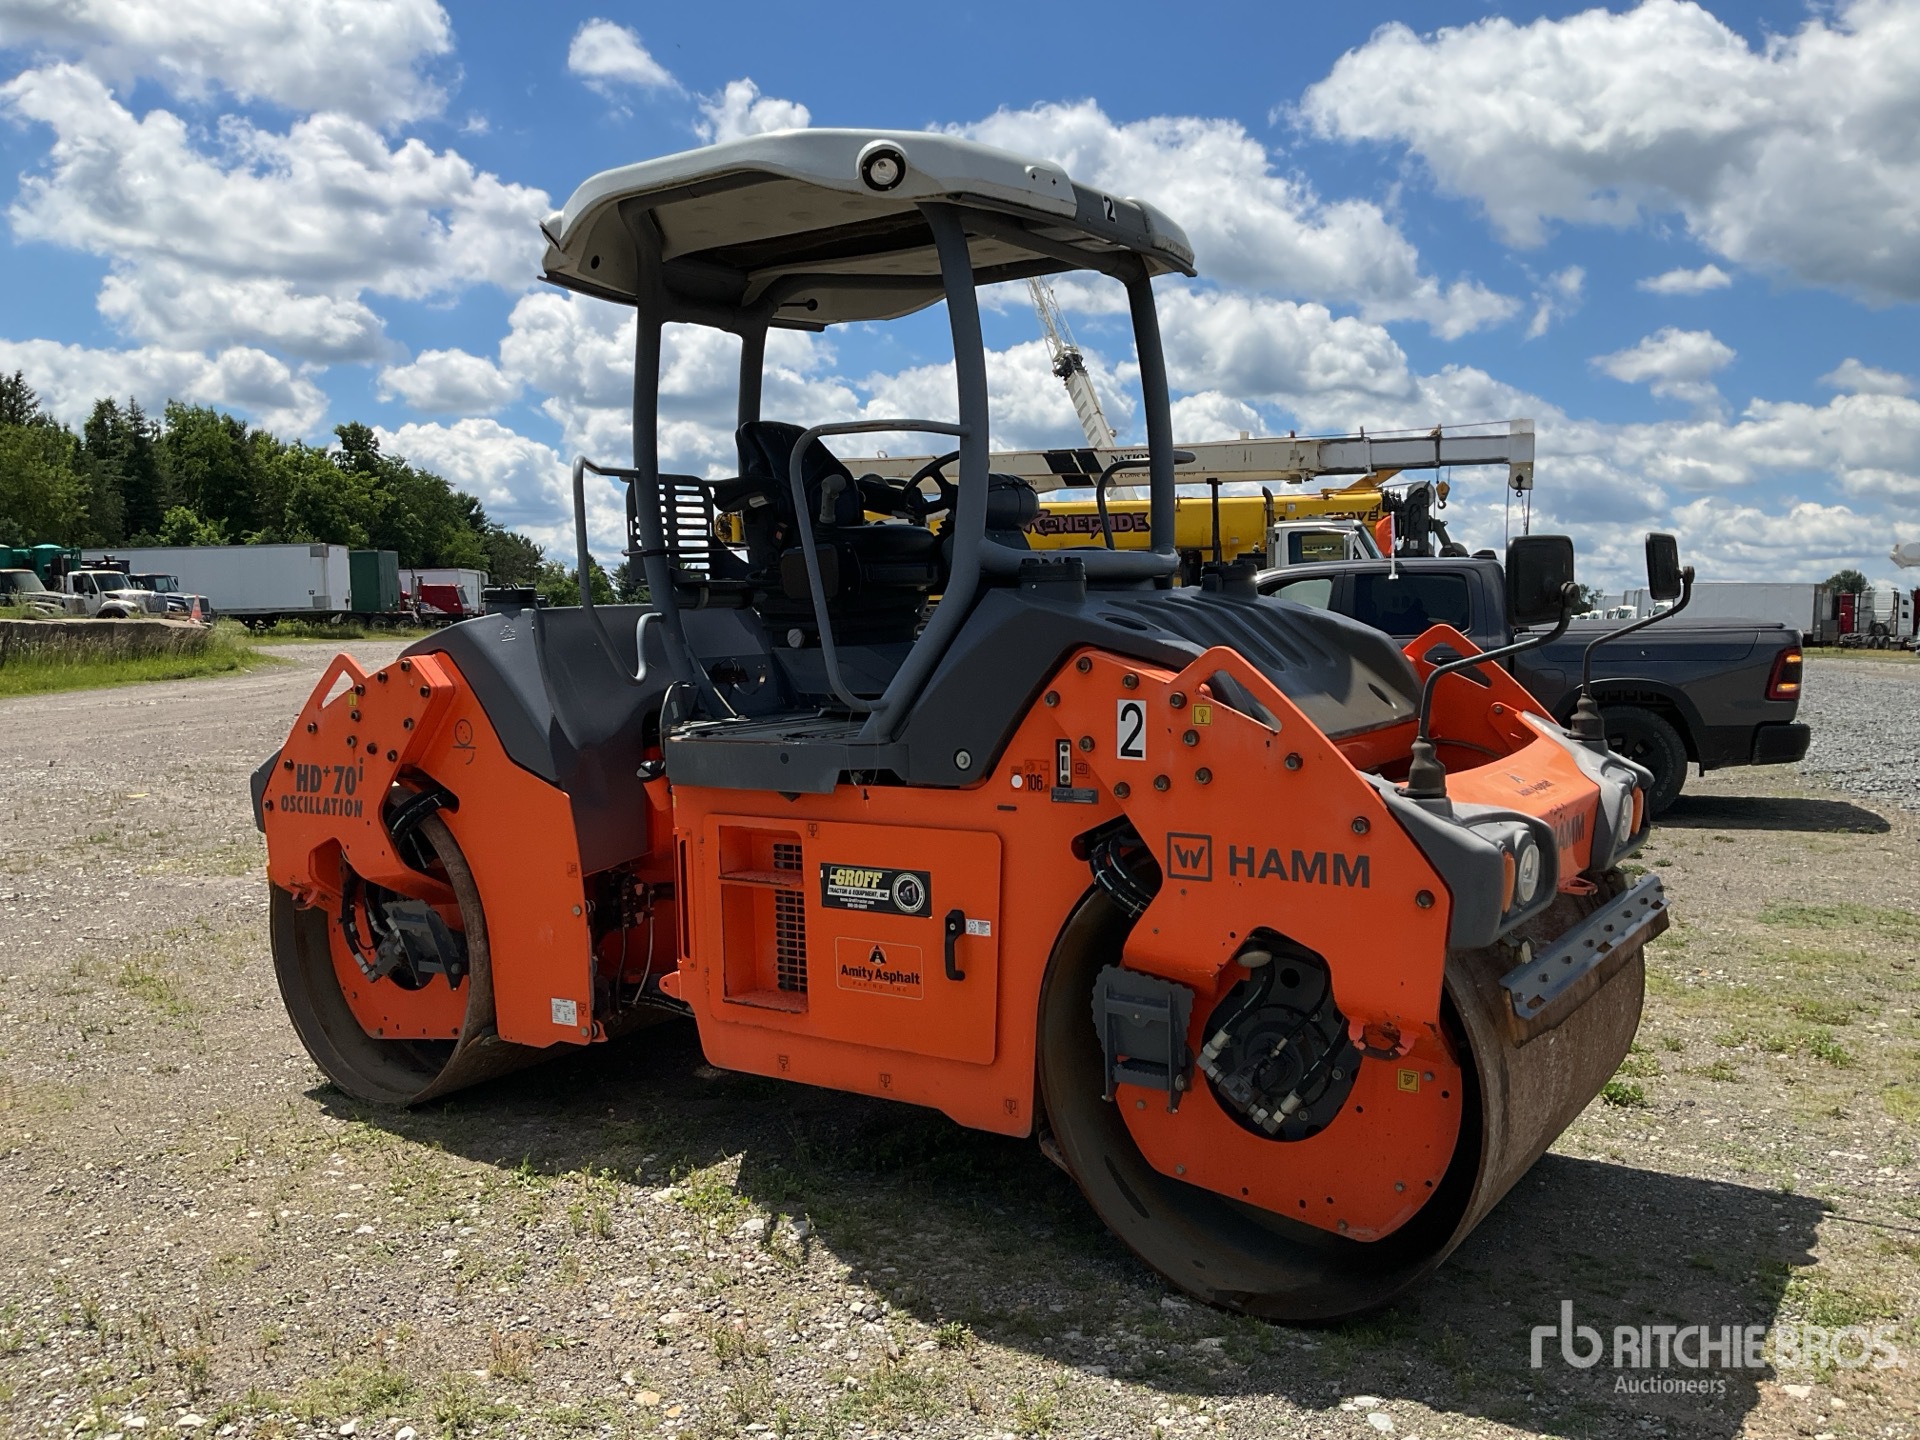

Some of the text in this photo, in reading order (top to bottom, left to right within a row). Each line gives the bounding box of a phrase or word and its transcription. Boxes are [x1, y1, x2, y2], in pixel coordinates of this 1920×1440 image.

[1103, 195, 1116, 222] 2
[1120, 702, 1144, 758] 2
[1026, 773, 1043, 792] 106
[281, 795, 363, 817] OSCILLATION
[1228, 844, 1371, 889] HAMM
[835, 869, 883, 888] GROFF
[841, 964, 920, 984] Amity Asphalt
